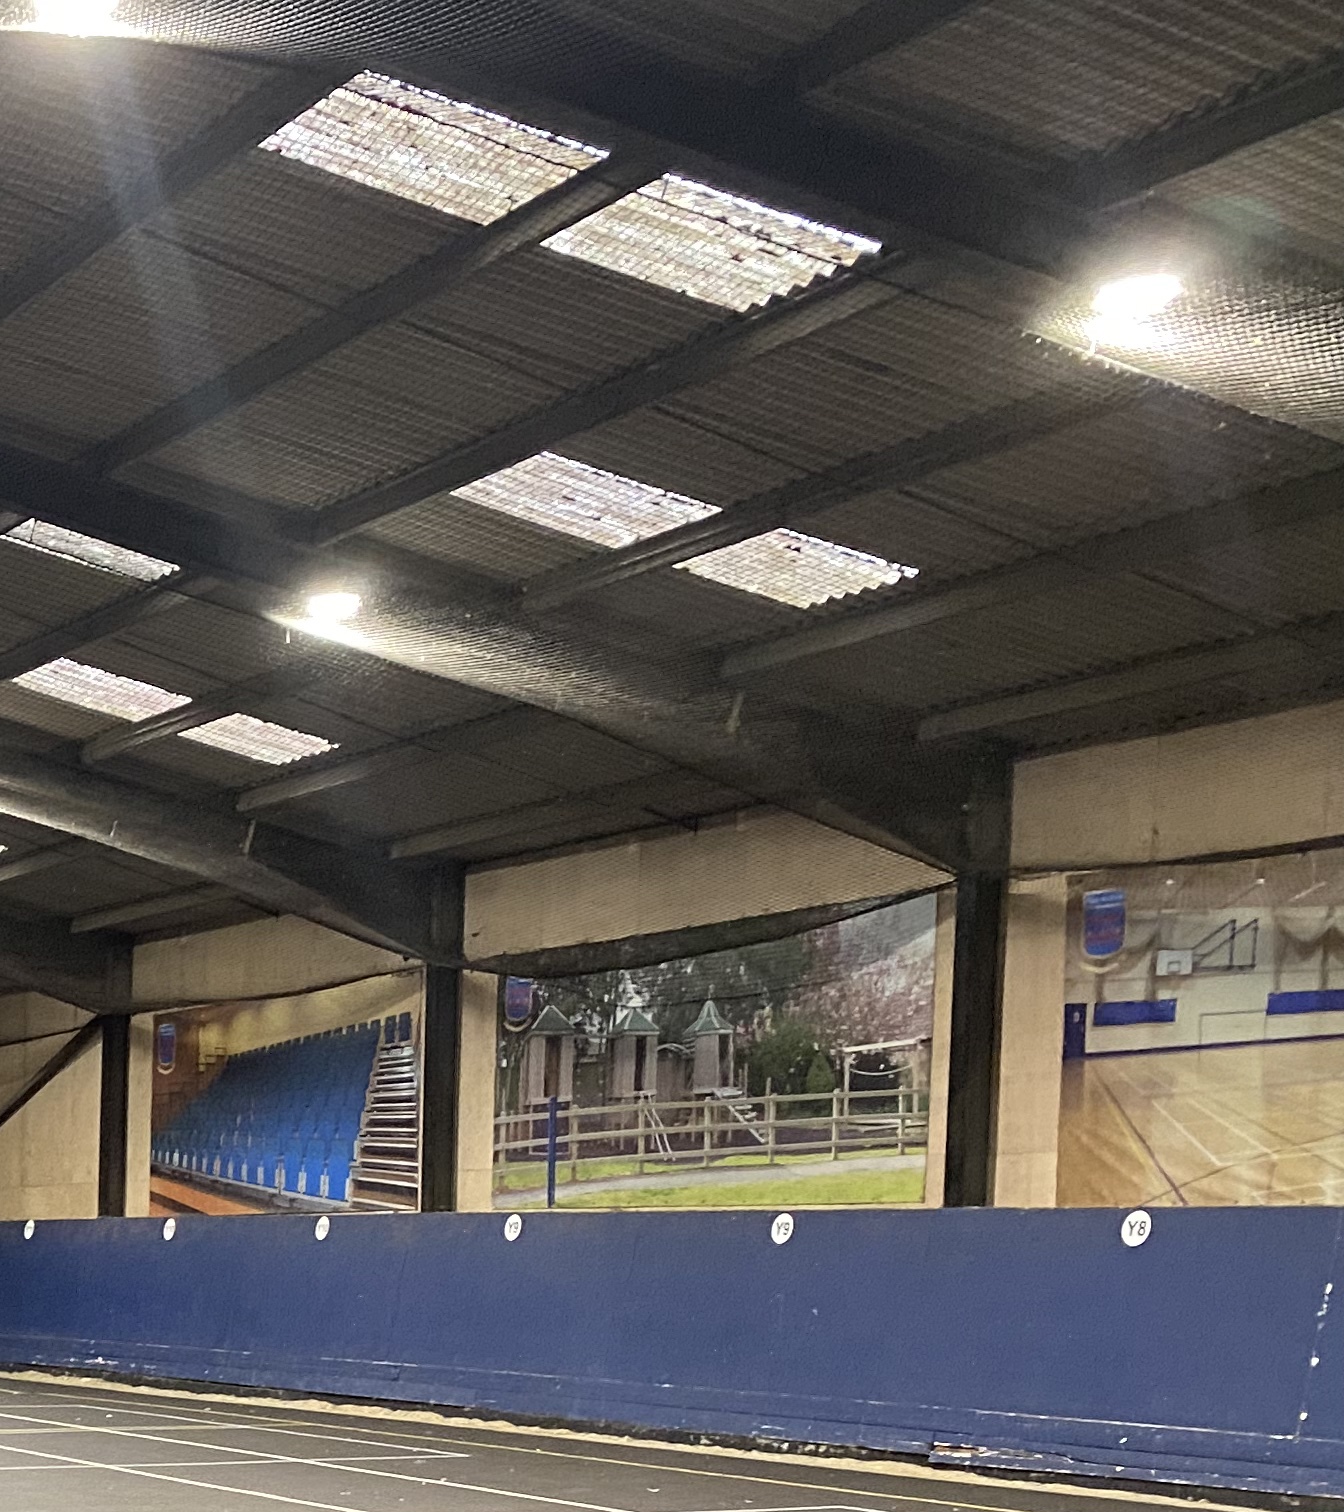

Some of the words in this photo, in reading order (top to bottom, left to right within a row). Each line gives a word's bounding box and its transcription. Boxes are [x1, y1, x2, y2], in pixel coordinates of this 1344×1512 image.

[508, 1221, 519, 1234] Y9
[776, 1222, 790, 1236] Y9
[1128, 1220, 1146, 1236] Y8
